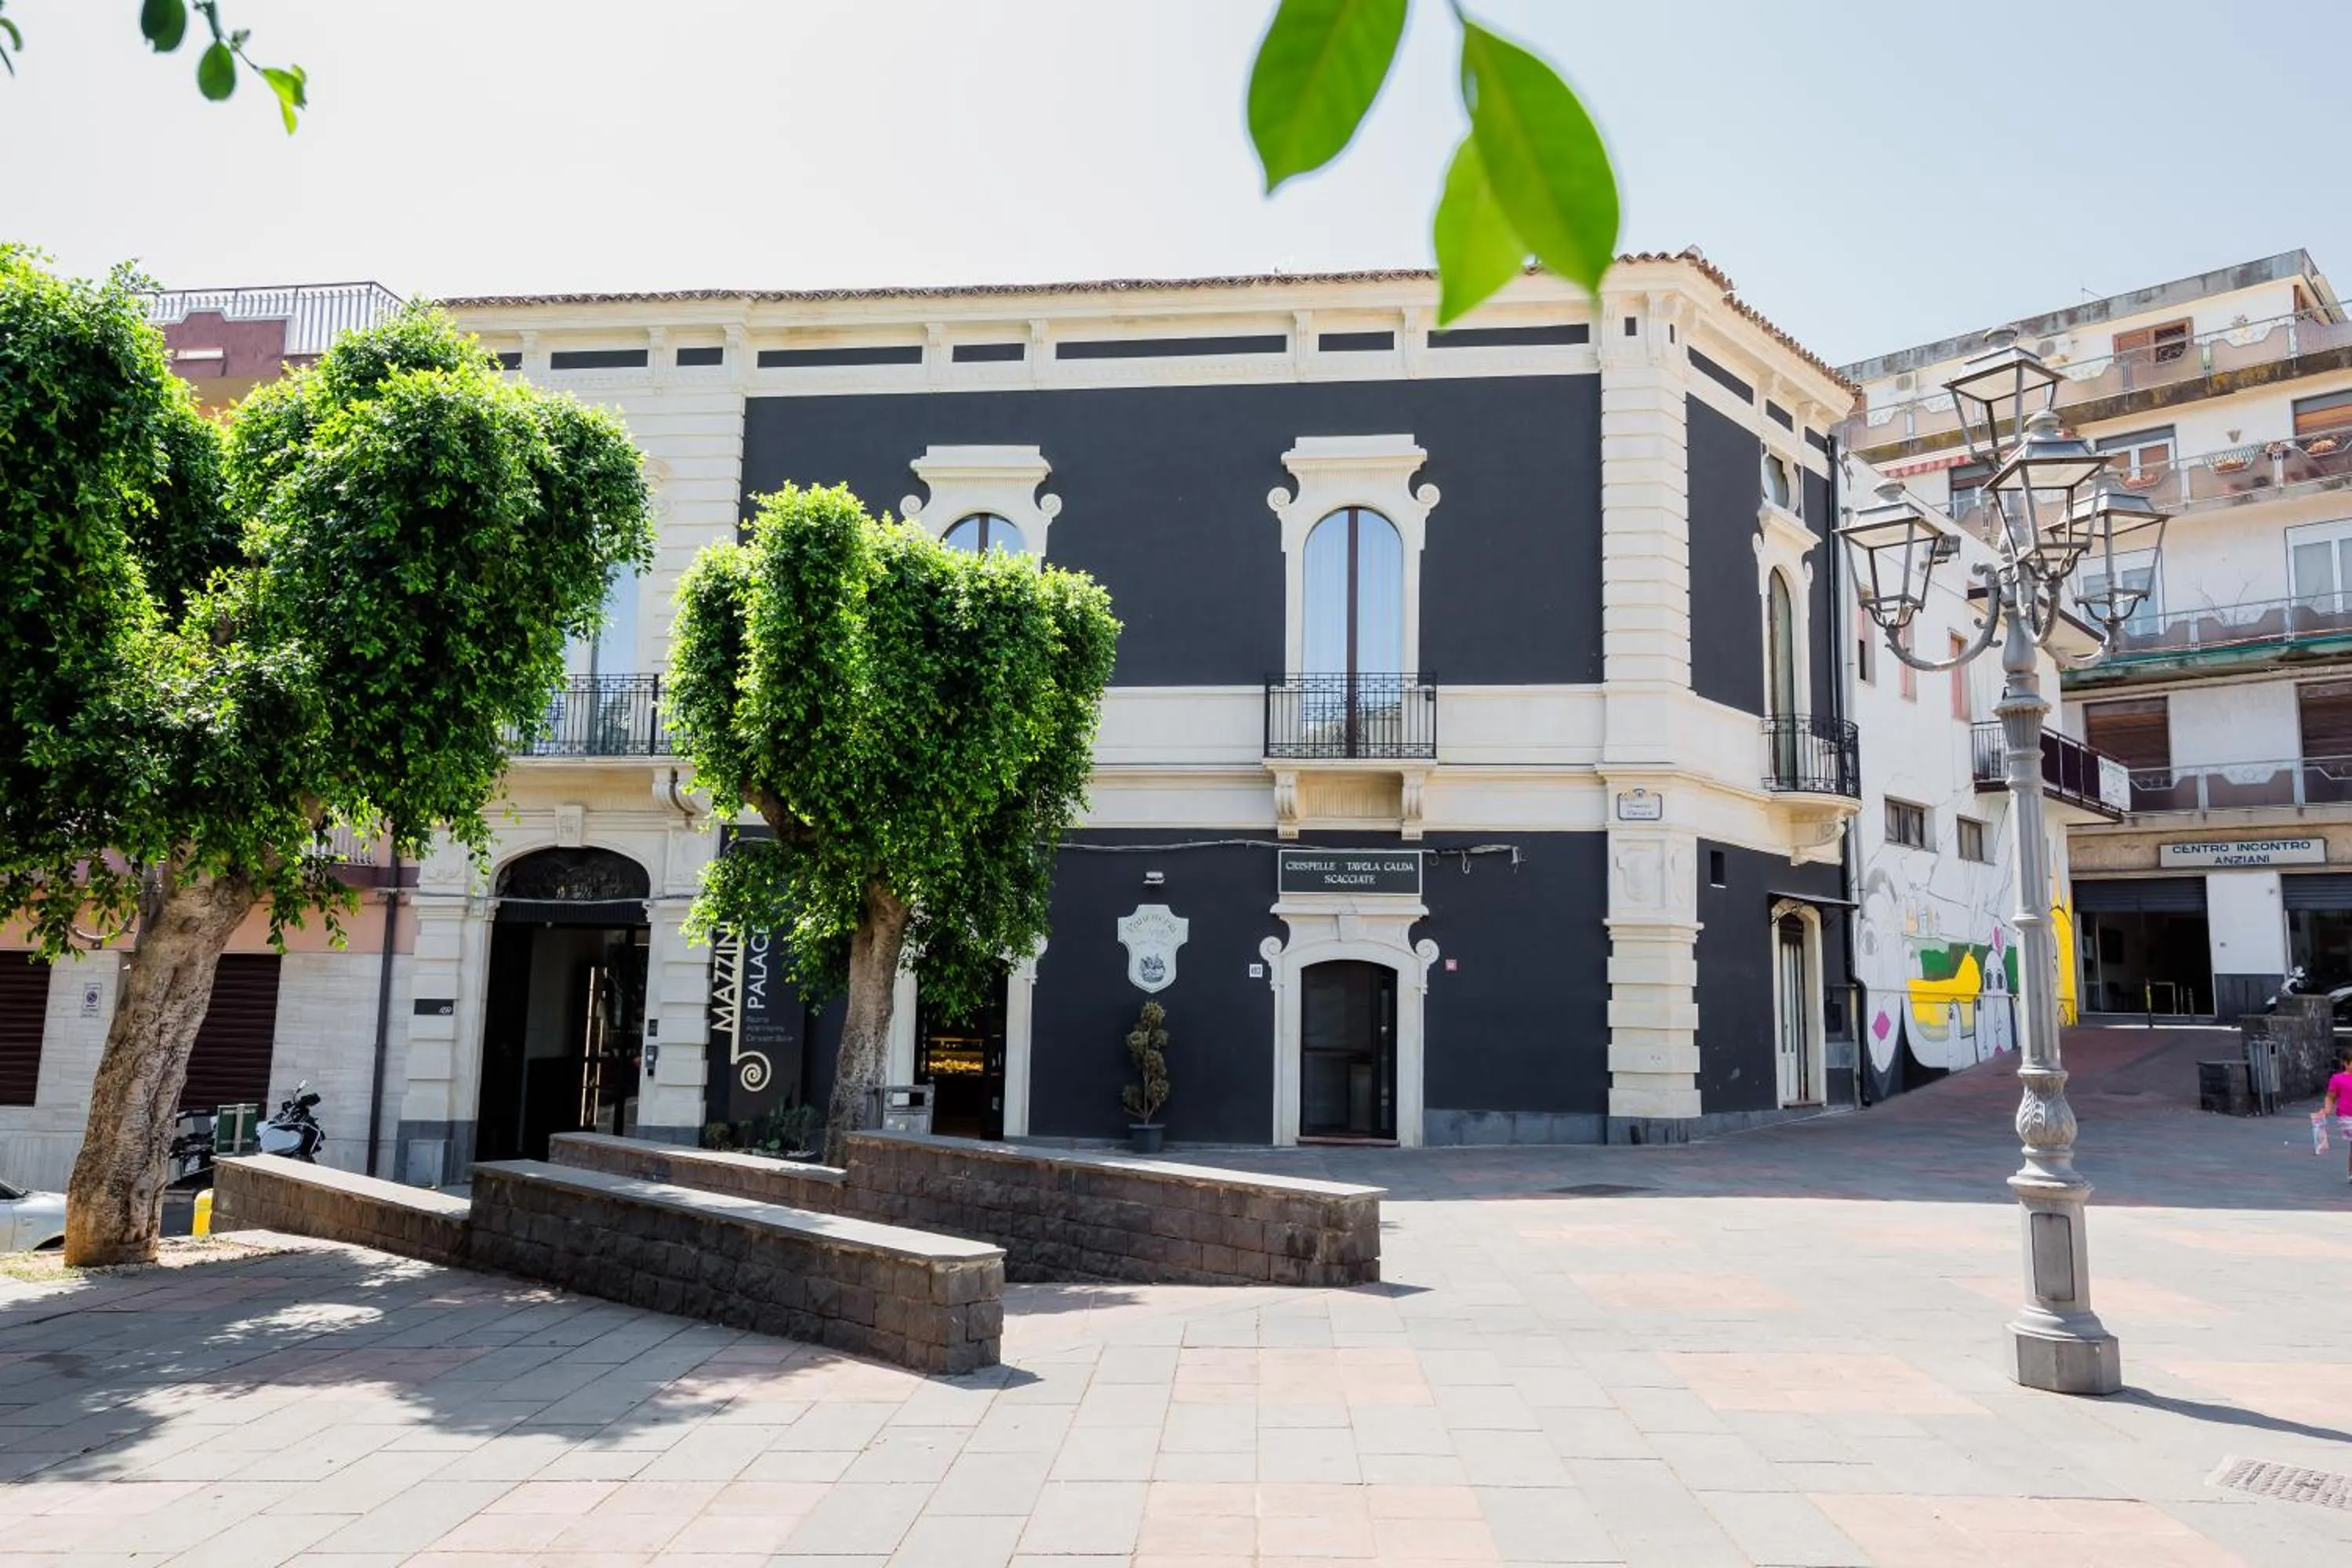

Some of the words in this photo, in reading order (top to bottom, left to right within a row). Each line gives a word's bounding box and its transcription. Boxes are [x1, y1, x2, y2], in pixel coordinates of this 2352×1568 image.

[2172, 844, 2230, 854] CENTRO
[2237, 841, 2311, 851] INCONTRO
[2214, 854, 2270, 865] ANZIANI
[1347, 862, 1381, 871] TAVOLA
[1384, 862, 1414, 871] CALDA
[1324, 874, 1376, 884] SCACCIATE
[747, 924, 769, 1009] PALACE
